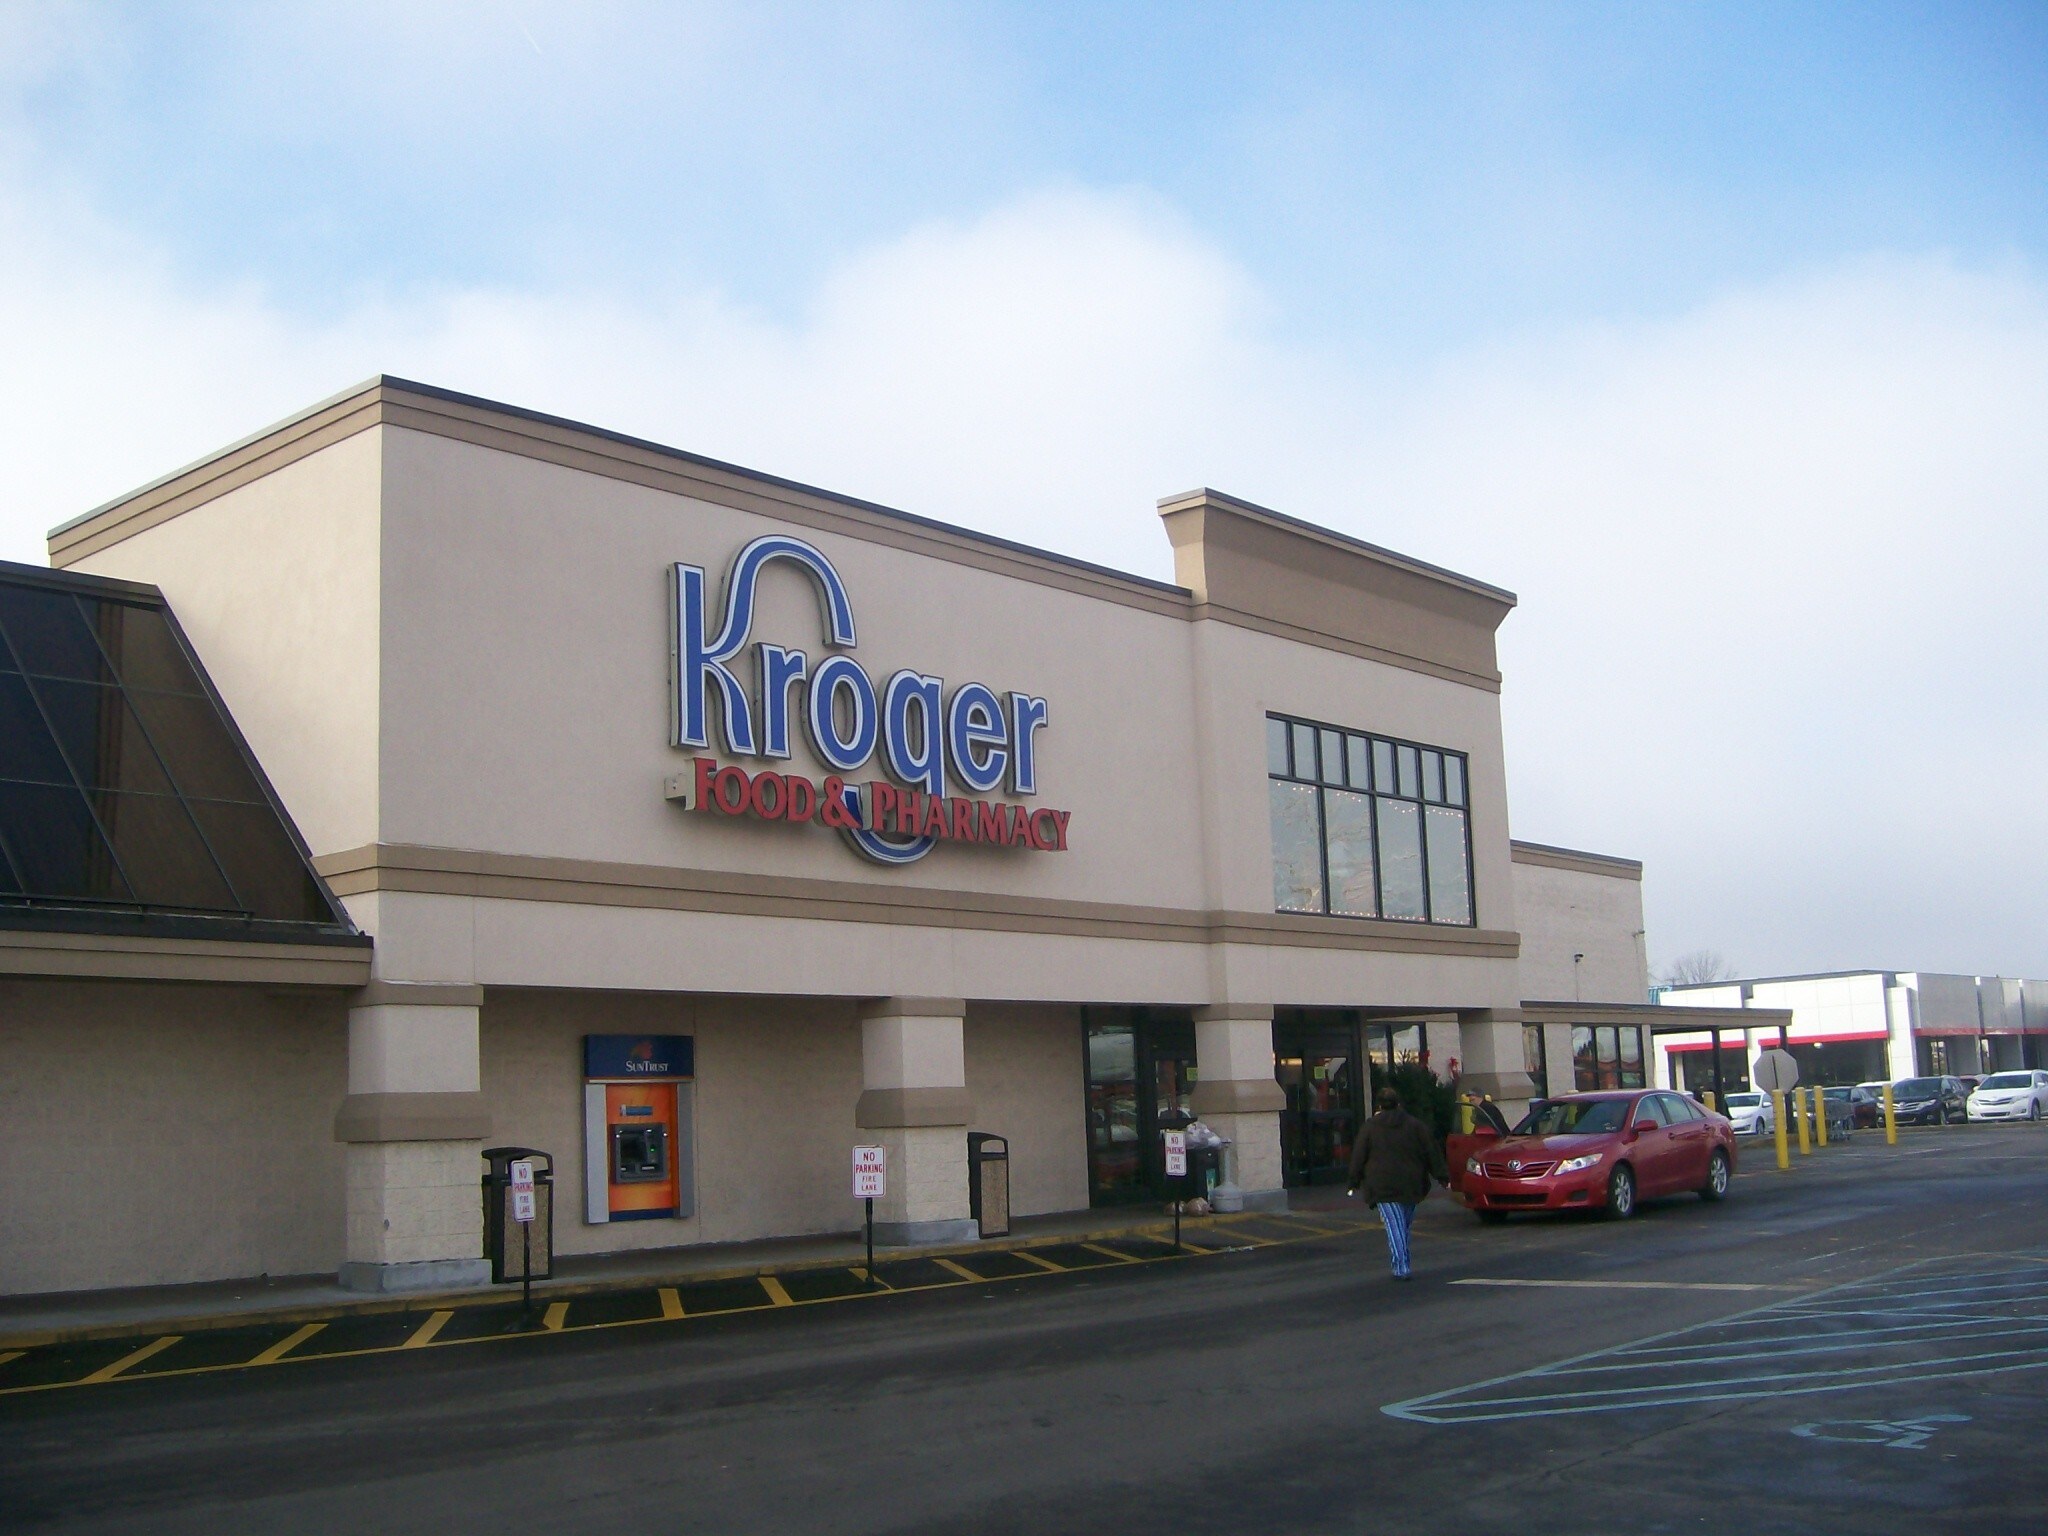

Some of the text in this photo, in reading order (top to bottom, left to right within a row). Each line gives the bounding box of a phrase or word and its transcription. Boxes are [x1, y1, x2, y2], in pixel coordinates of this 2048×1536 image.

[672, 534, 1049, 864] Kroger
[693, 757, 1072, 852] FOOD & PHARMACY
[863, 1152, 876, 1161] NO
[519, 1167, 527, 1179] NO
[855, 1163, 883, 1174] PARKING
[862, 1175, 877, 1183] FIRE
